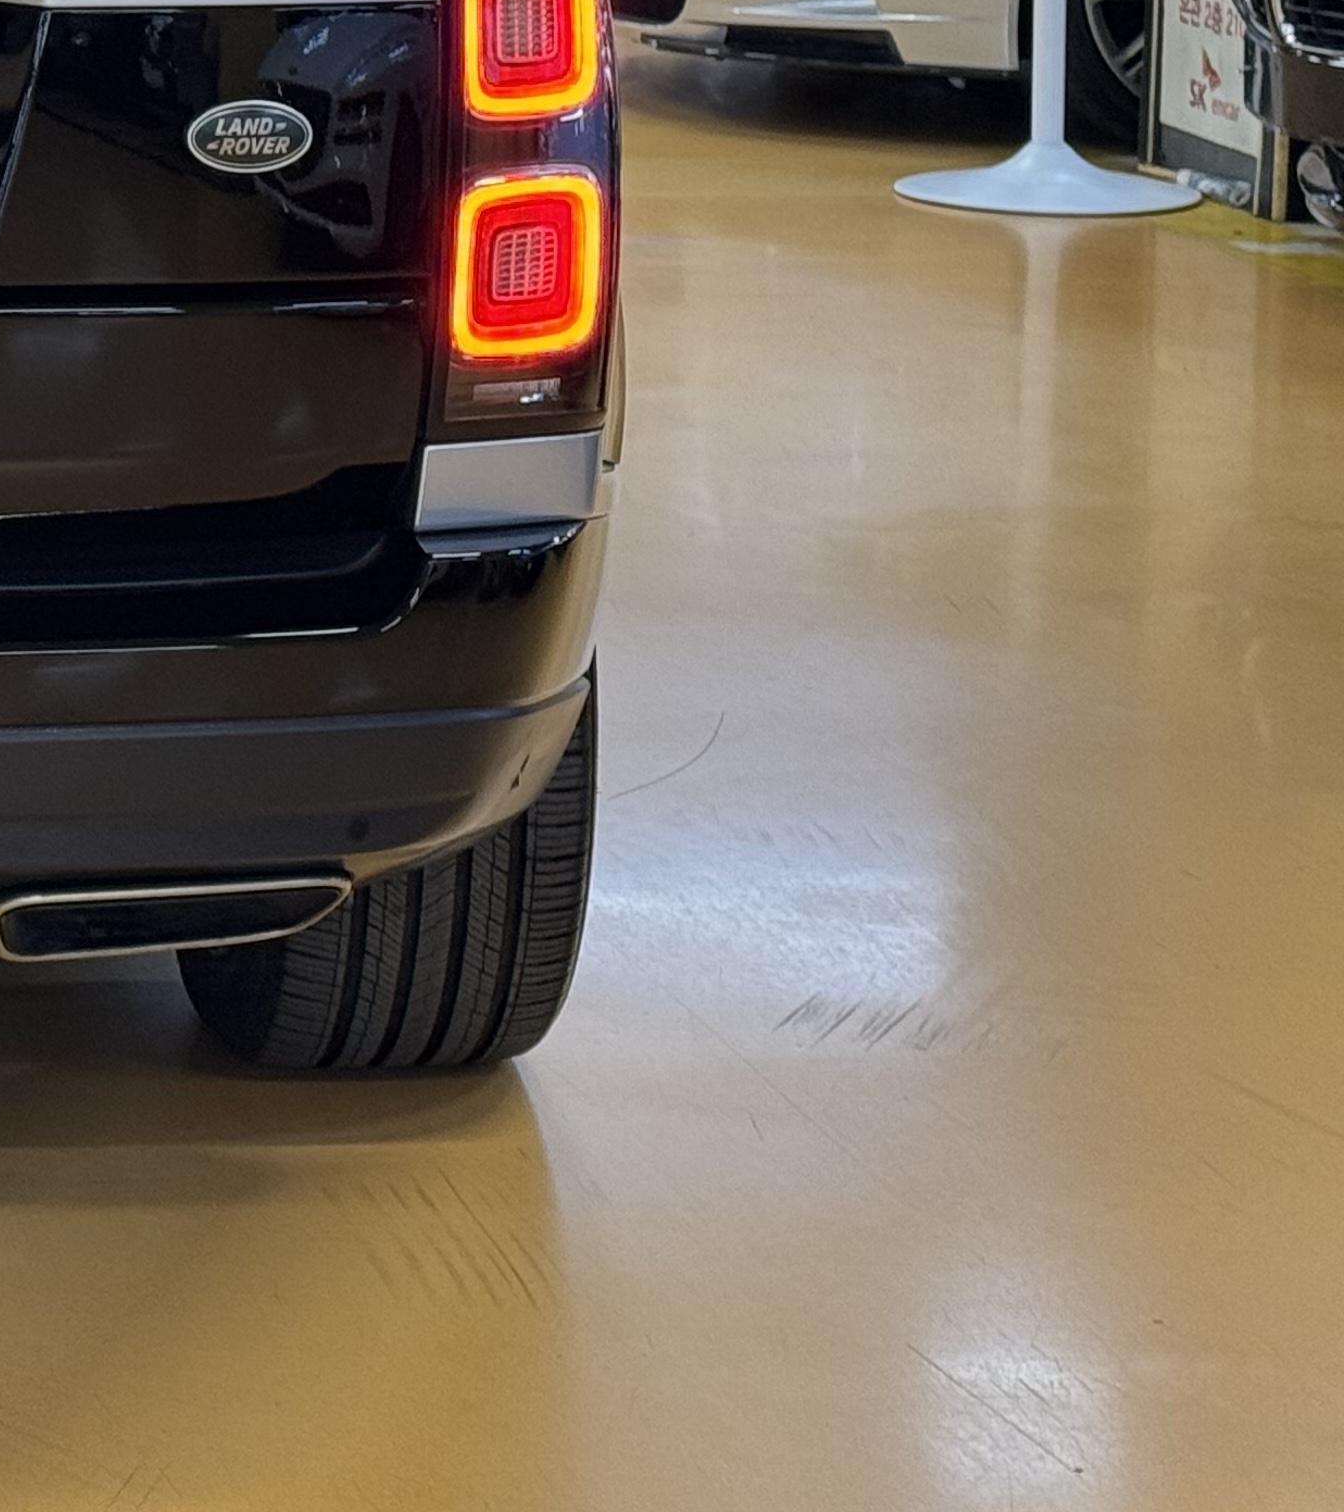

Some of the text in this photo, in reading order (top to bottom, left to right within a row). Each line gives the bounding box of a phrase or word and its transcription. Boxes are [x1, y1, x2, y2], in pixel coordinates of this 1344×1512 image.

[1189, 78, 1207, 113] SK
[215, 117, 273, 136] LAND
[219, 136, 290, 155] ROVER
